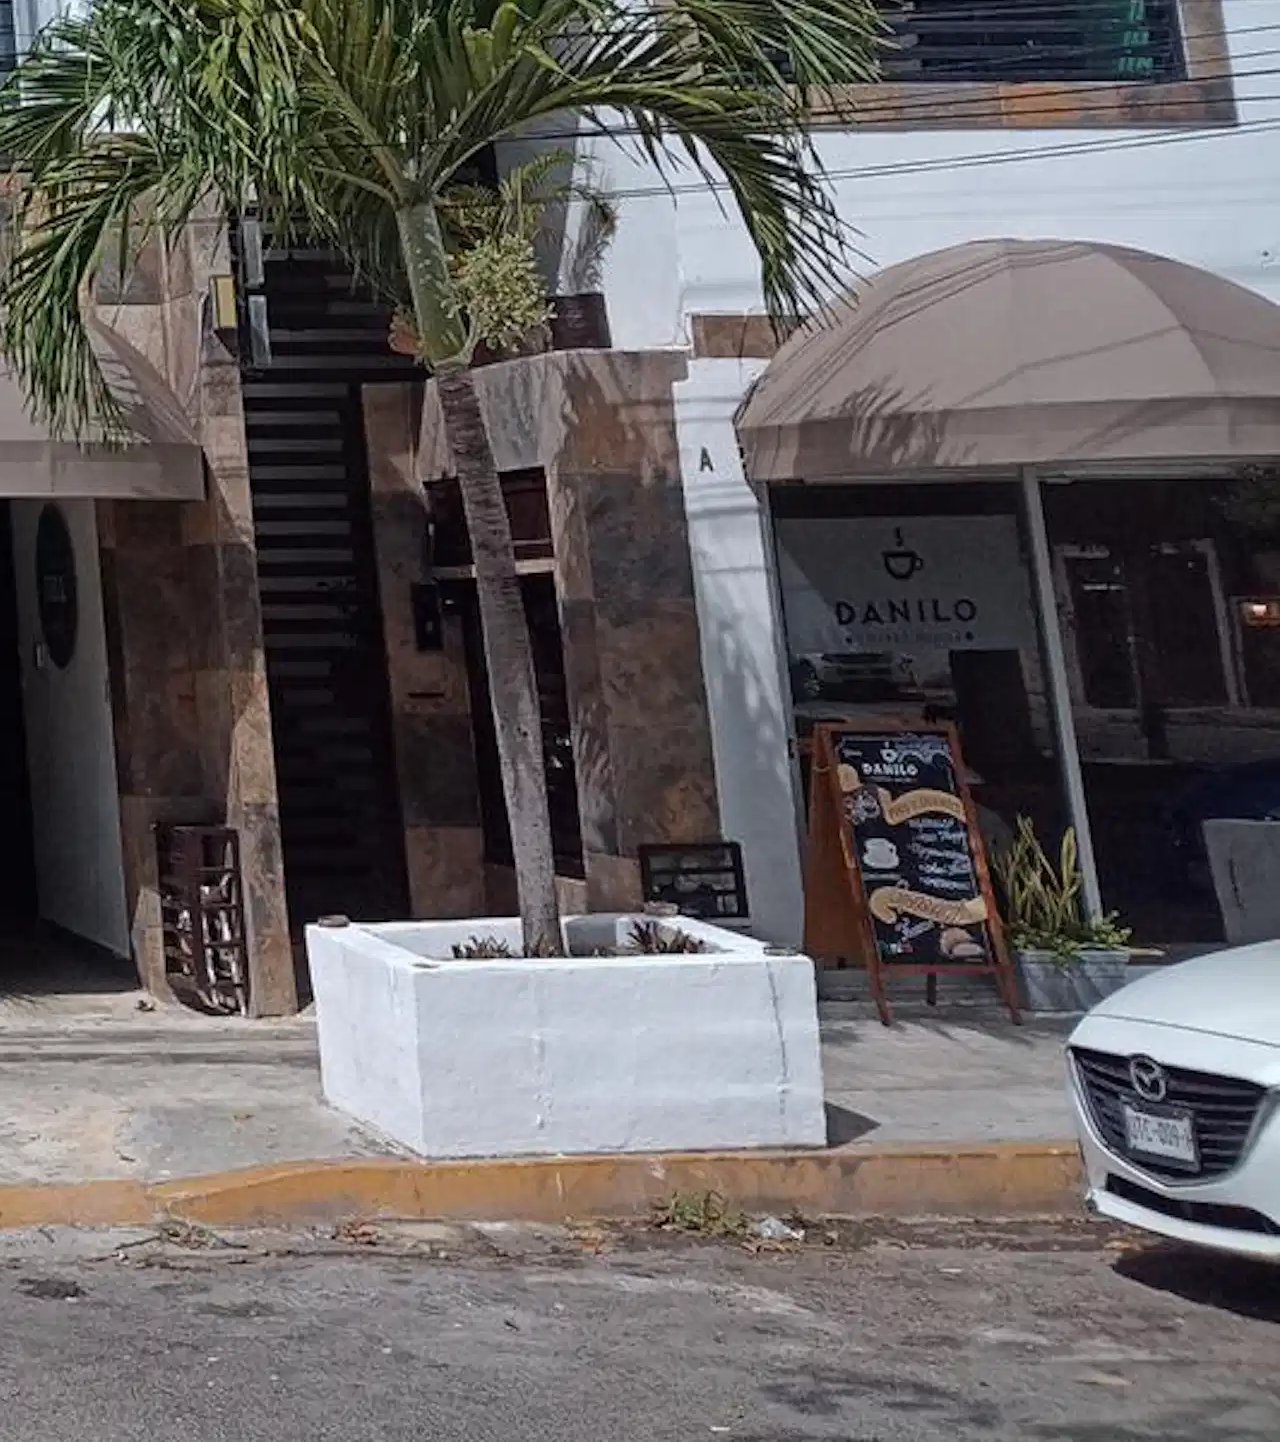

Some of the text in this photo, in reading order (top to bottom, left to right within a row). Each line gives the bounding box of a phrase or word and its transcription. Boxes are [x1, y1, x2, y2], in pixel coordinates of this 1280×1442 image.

[700, 446, 713, 472] A
[834, 598, 977, 625] DANILO
[861, 762, 919, 776] DANILO
